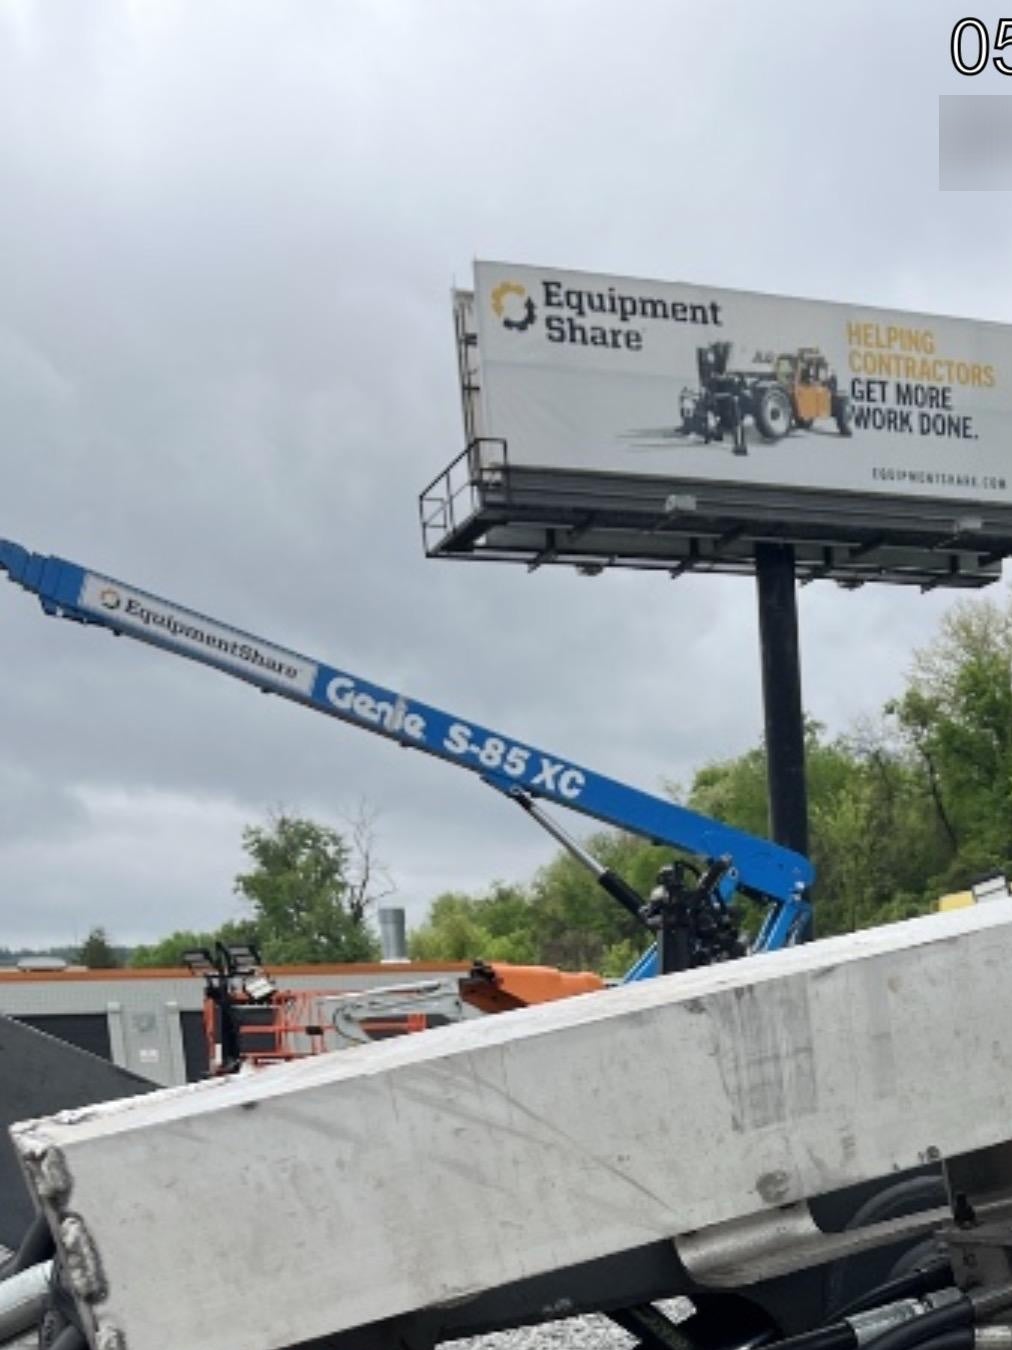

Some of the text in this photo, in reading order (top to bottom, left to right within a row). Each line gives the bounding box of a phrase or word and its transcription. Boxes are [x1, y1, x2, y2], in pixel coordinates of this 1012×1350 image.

[542, 280, 723, 326] Equipment
[545, 315, 643, 350] Share
[846, 321, 935, 355] HELPING
[848, 350, 996, 388] CONTRACTORS
[851, 377, 953, 411] GET MORE
[851, 405, 979, 440] WORK DONE.
[124, 598, 299, 679] EquipmentShare
[326, 676, 586, 799] Genie S-85 XC
